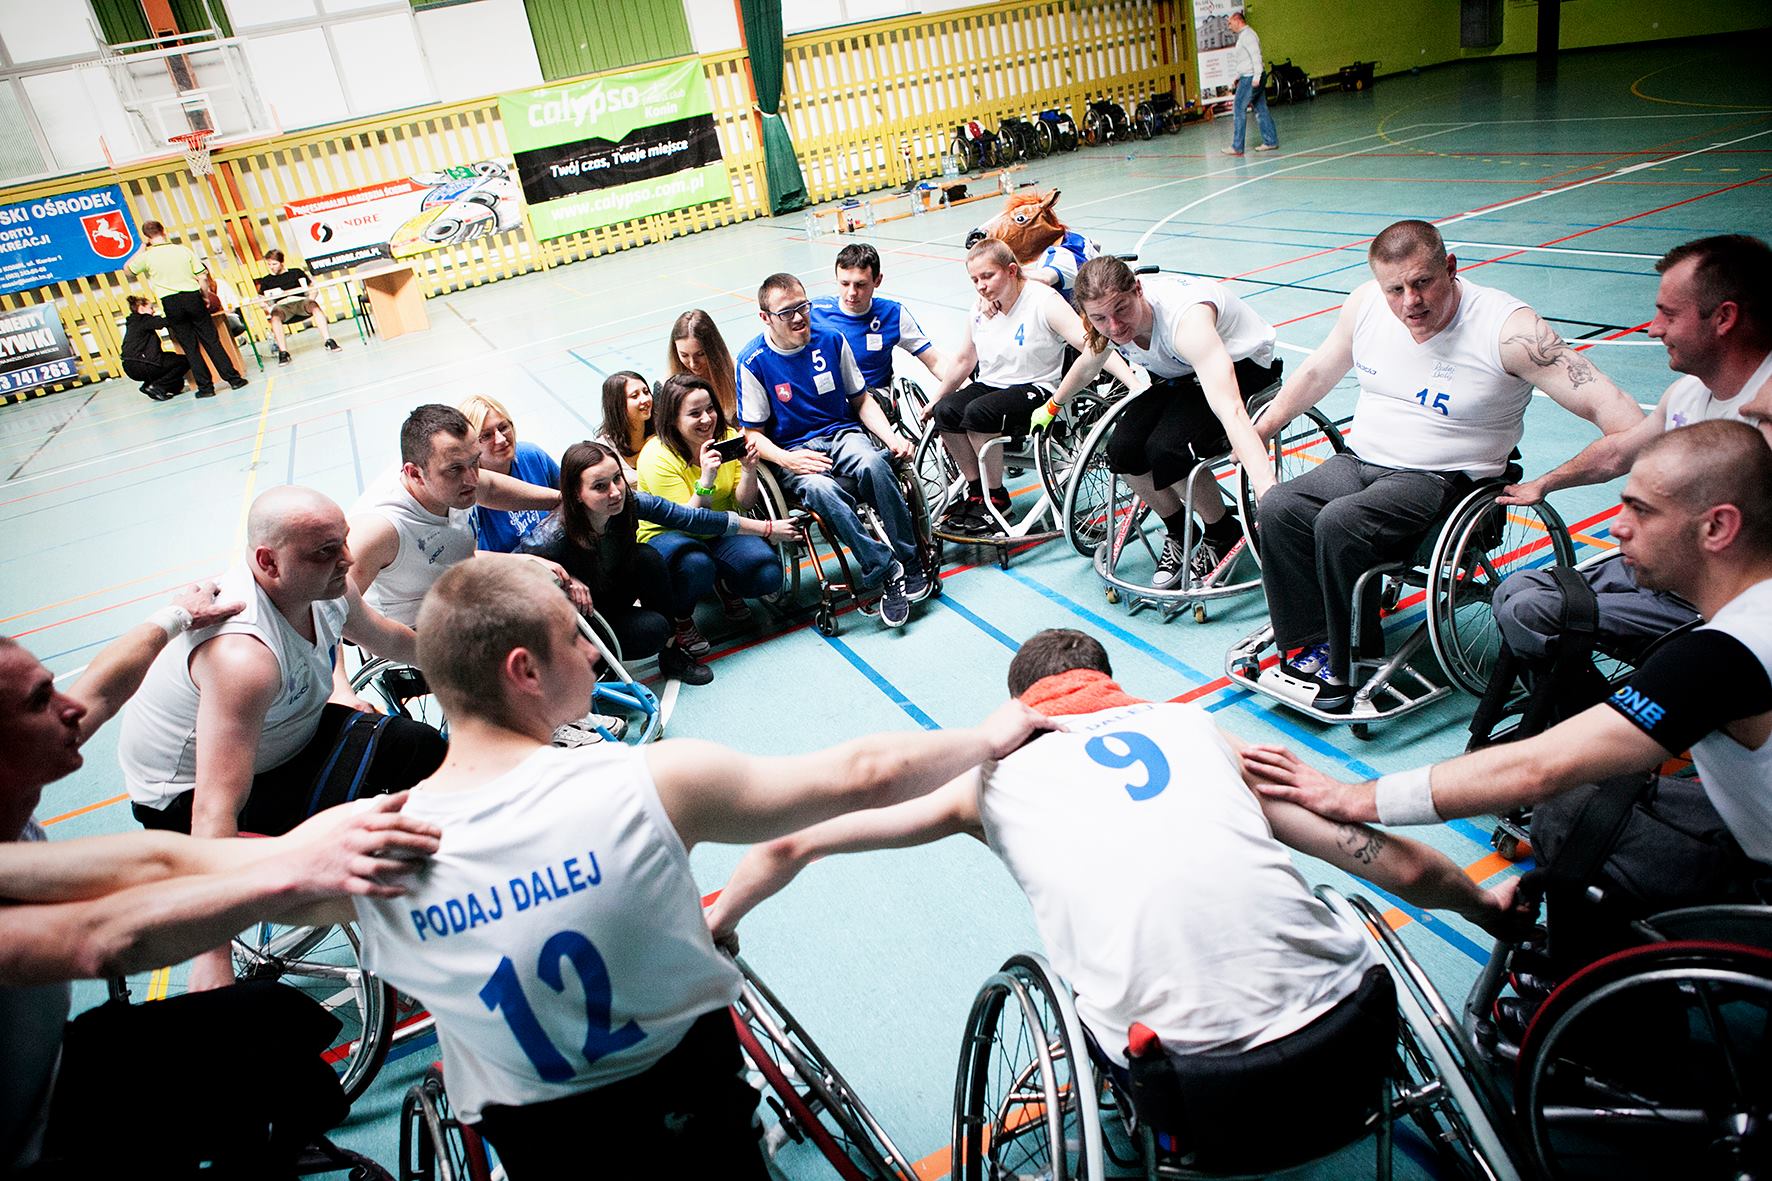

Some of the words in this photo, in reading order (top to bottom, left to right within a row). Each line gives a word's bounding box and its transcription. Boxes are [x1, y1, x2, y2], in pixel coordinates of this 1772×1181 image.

[528, 80, 640, 128] calypso
[644, 103, 678, 119] Konin
[550, 162, 580, 178] Twój
[581, 156, 611, 172] czas,
[611, 147, 647, 166] Twoje
[647, 139, 689, 158] miejsce
[31, 190, 116, 219] OŚRODEK
[551, 174, 704, 221] www.calypso.com.pl
[0, 311, 46, 335] MENTY
[869, 316, 881, 332] 6
[1014, 323, 1025, 346] 4
[11, 368, 39, 386] 747
[40, 361, 71, 380] 263
[811, 349, 827, 372] 5
[1415, 387, 1451, 416] 15
[1613, 685, 1666, 725] ONE
[1084, 731, 1171, 802] 9
[410, 886, 503, 942] PODAJ
[508, 851, 603, 912] DALEJ
[478, 929, 648, 1084] 12
